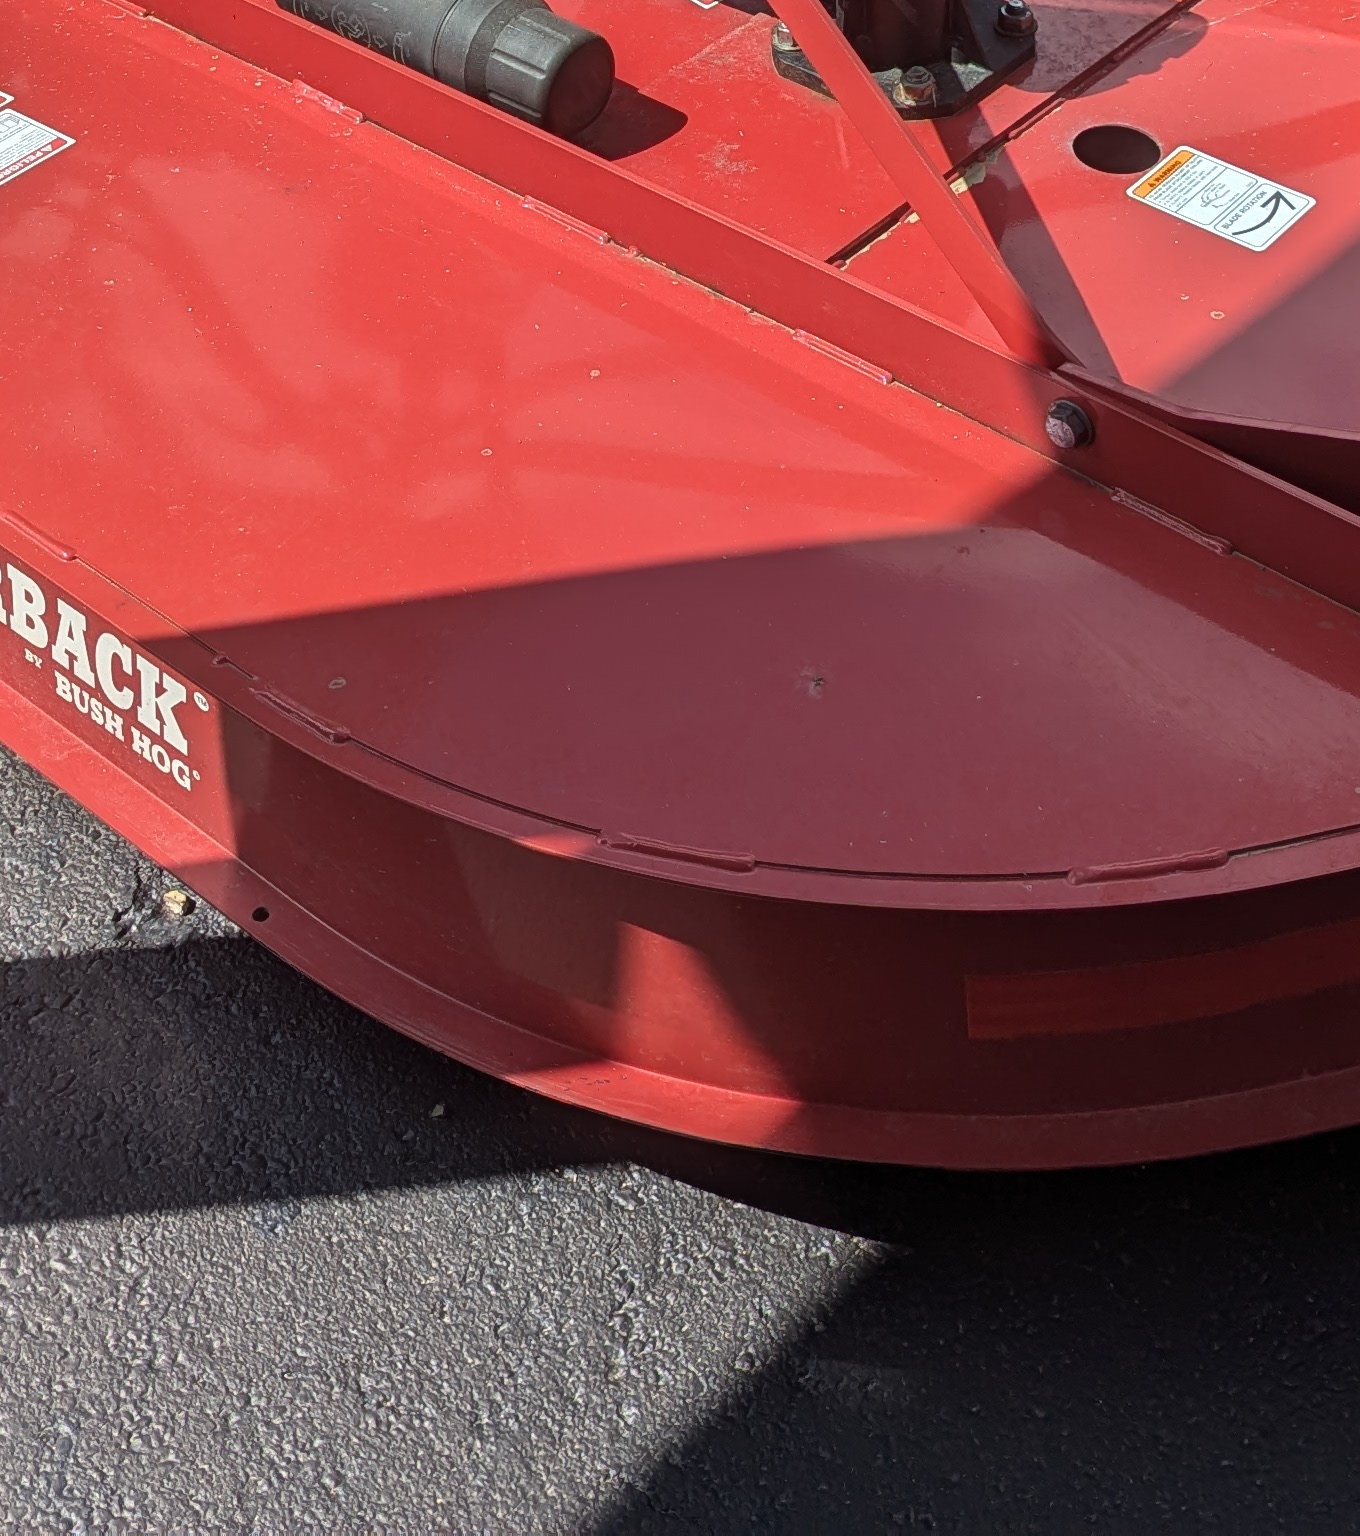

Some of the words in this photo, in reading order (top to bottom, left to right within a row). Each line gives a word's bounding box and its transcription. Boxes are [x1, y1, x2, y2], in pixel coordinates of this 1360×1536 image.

[1156, 160, 1182, 183] WARNING
[1221, 213, 1243, 229] BLADE
[1241, 191, 1267, 213] ROTATION
[24, 648, 42, 669] BY
[54, 670, 124, 742] BUSH
